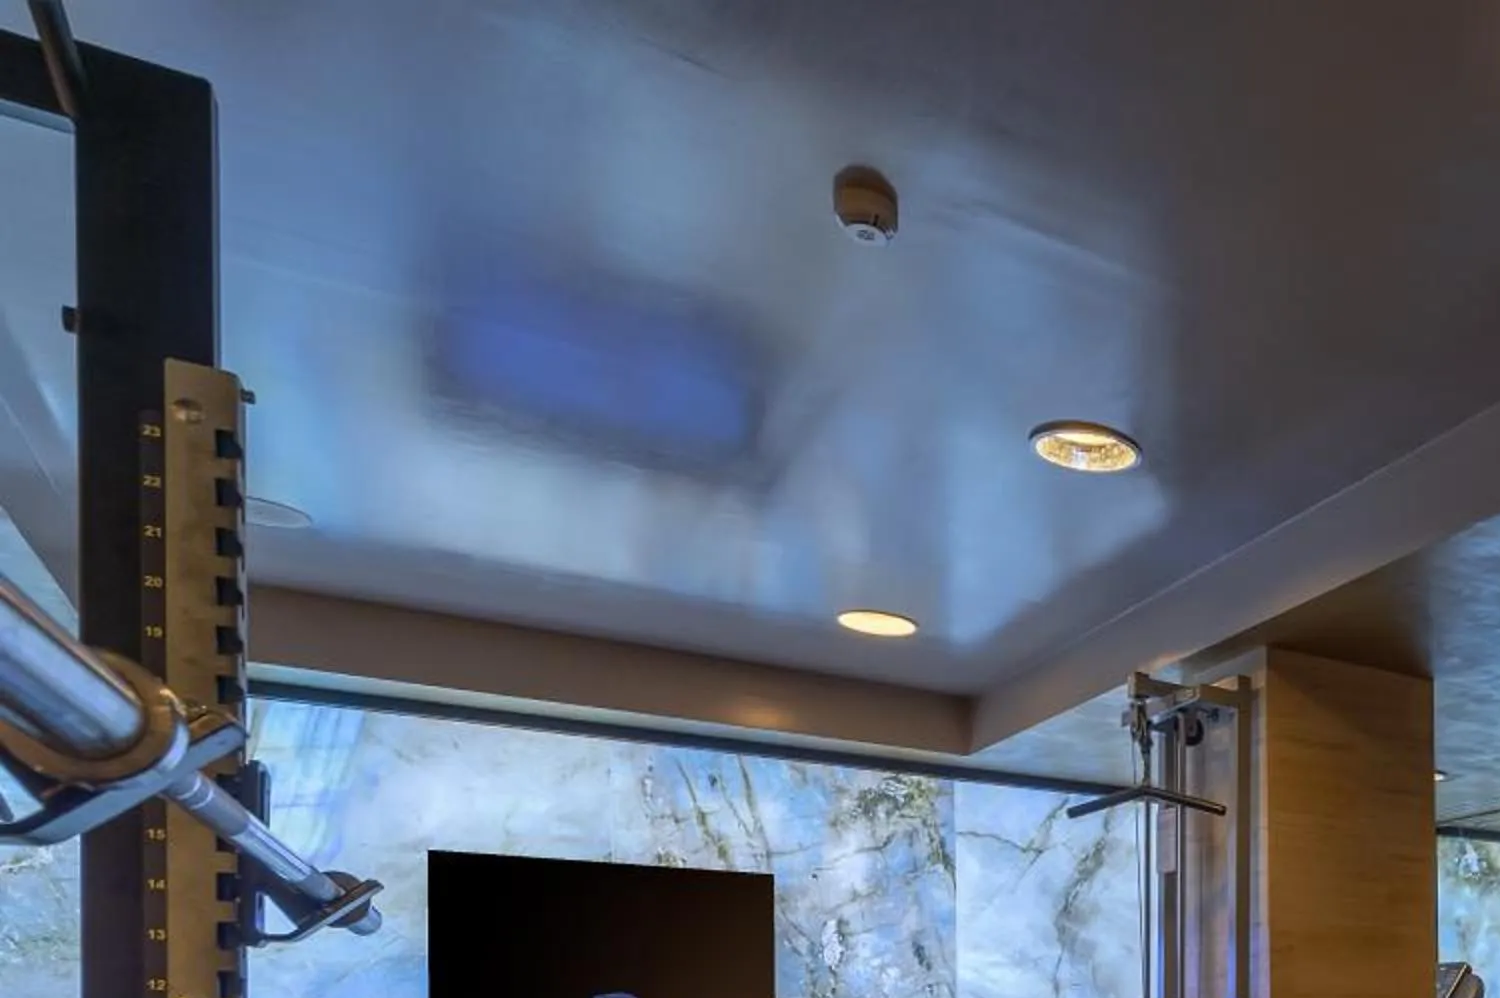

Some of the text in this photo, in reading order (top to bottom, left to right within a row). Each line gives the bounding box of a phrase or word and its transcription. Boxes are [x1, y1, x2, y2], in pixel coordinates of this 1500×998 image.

[142, 424, 161, 438] 23
[143, 474, 161, 488] 22
[144, 524, 162, 538] 21
[144, 575, 163, 588] 20
[145, 625, 163, 638] 19
[147, 828, 166, 840] 15
[147, 878, 166, 890] 14
[148, 928, 166, 941] 13
[147, 978, 166, 991] 12
